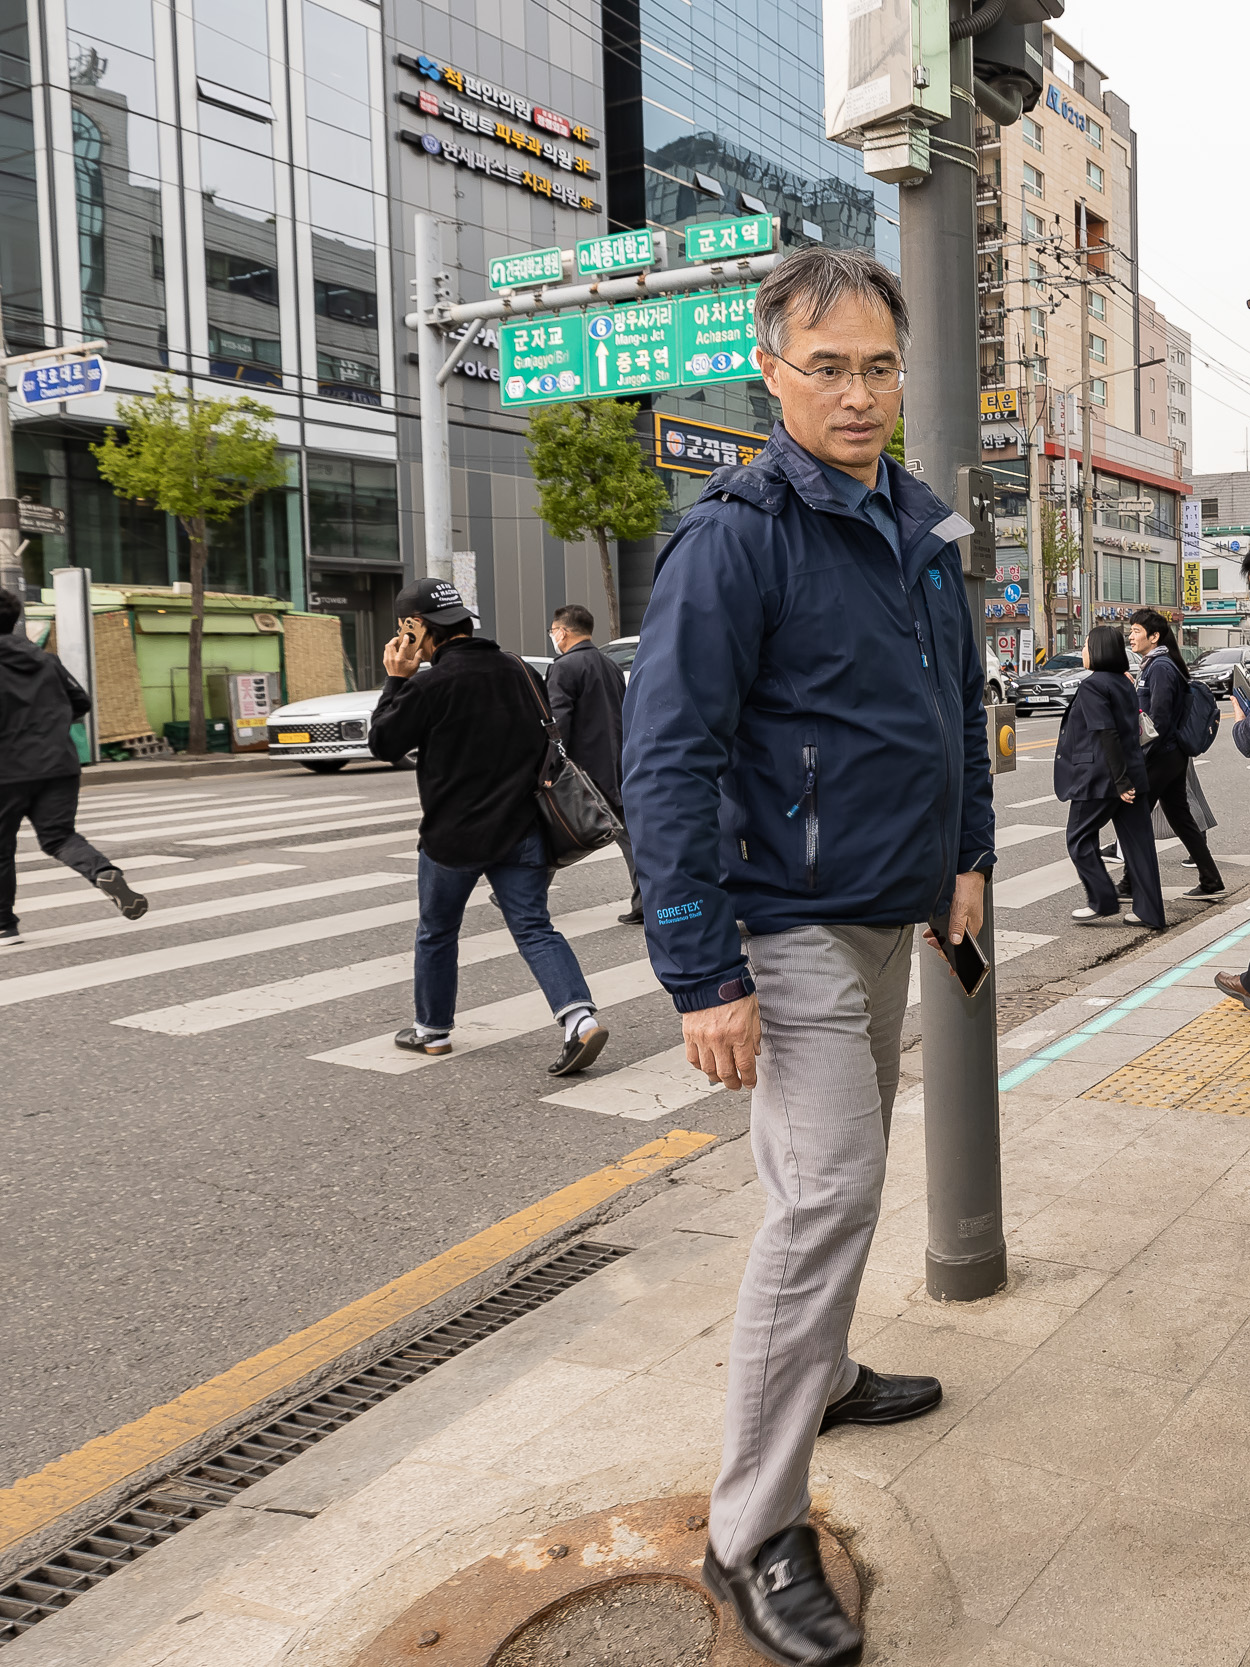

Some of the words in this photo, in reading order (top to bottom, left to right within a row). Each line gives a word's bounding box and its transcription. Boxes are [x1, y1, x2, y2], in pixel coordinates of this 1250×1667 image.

[444, 66, 532, 122] 척편안의원
[573, 125, 590, 142] 4F
[443, 101, 572, 171] 그랜트피부과의원
[575, 156, 591, 172] 3F
[442, 138, 580, 208] 연세퍼스트치과의원
[581, 195, 594, 209] 3F
[698, 221, 760, 252] 군자역
[588, 235, 651, 270] 세종대학교
[614, 305, 673, 332] 망우사거리
[513, 326, 564, 352] 군자교
[615, 333, 649, 347] Mang-u
[650, 330, 665, 342] Jct
[695, 329, 741, 345] Achasan
[616, 345, 669, 374] 중곡역
[36, 364, 84, 388] 천호대로
[617, 372, 651, 387] Junggok
[655, 369, 670, 382] Stn
[987, 393, 1014, 410] 타운
[1186, 563, 1199, 597] 부동산
[998, 635, 1016, 658] 약
[657, 900, 701, 919] GORE-TEX
